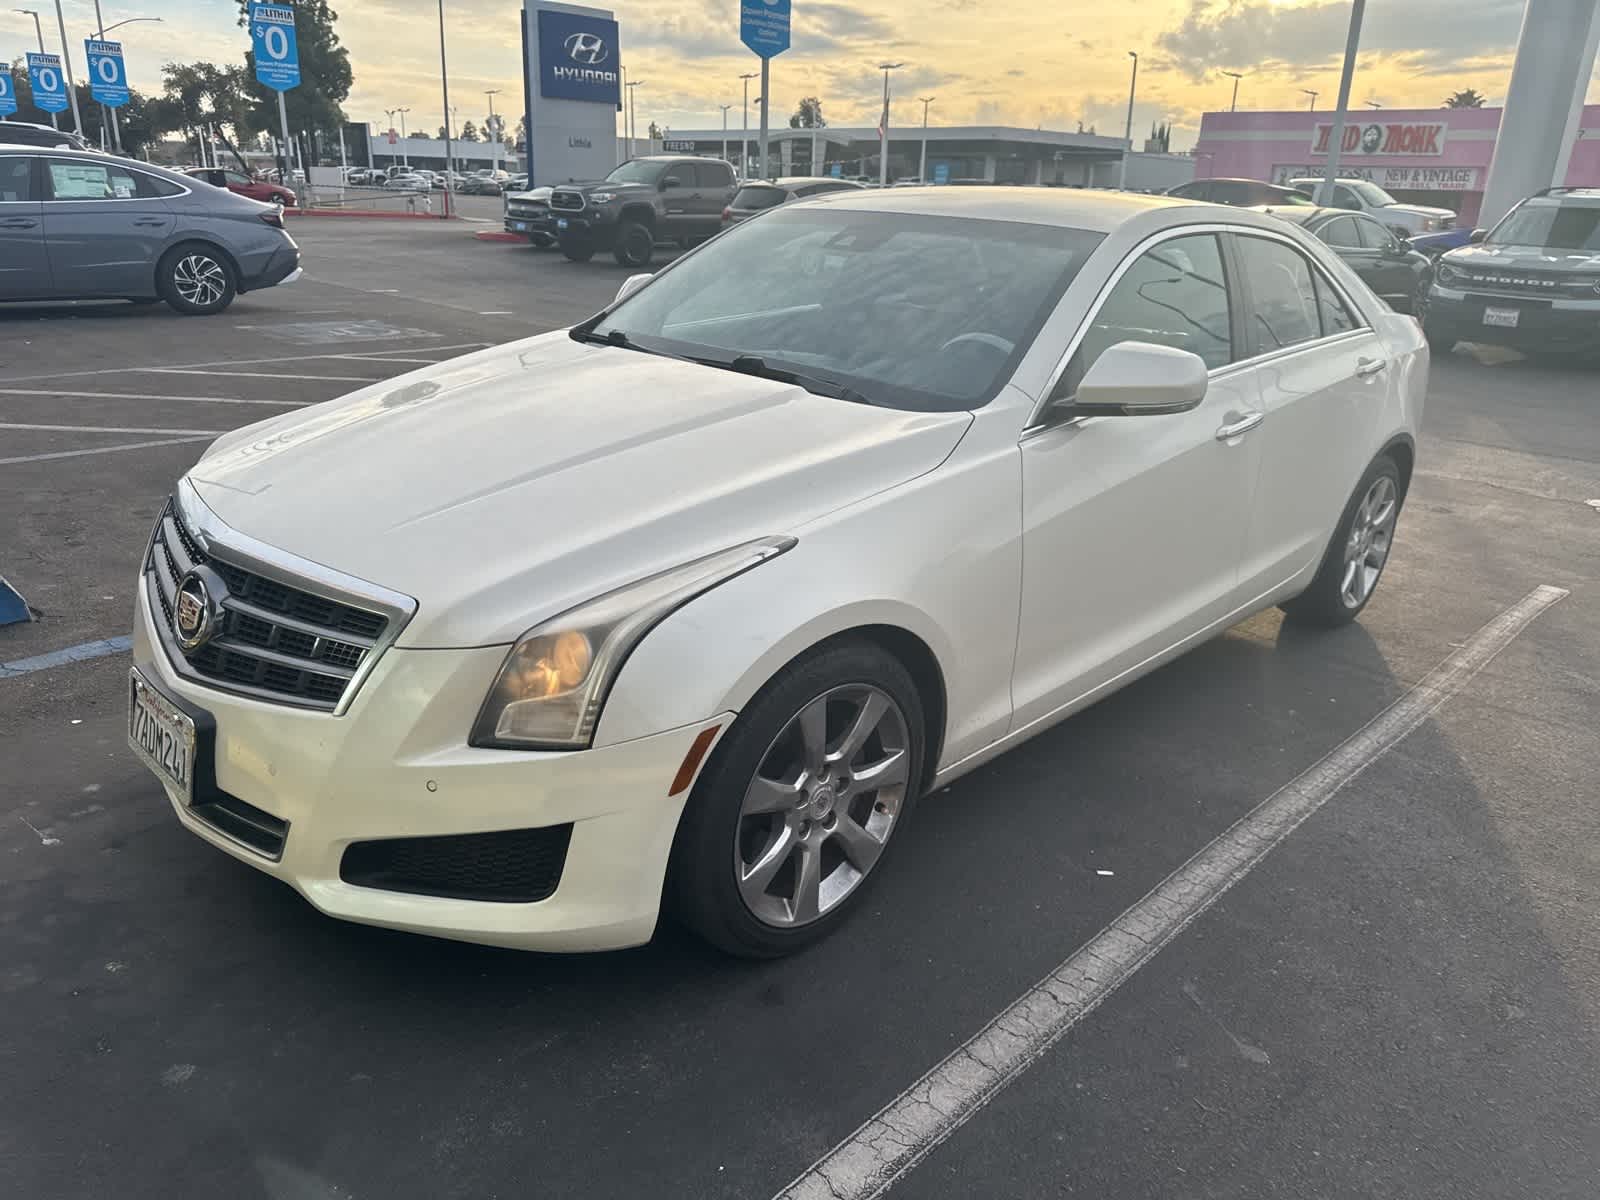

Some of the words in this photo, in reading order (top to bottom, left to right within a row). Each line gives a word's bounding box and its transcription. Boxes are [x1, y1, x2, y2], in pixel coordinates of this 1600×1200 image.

[265, 9, 293, 20] LITHIA
[554, 66, 617, 82] HYUNDAI
[1381, 125, 1442, 152] MONK
[1473, 275, 1555, 287] BRONCO
[136, 702, 187, 790] 7ADM241
